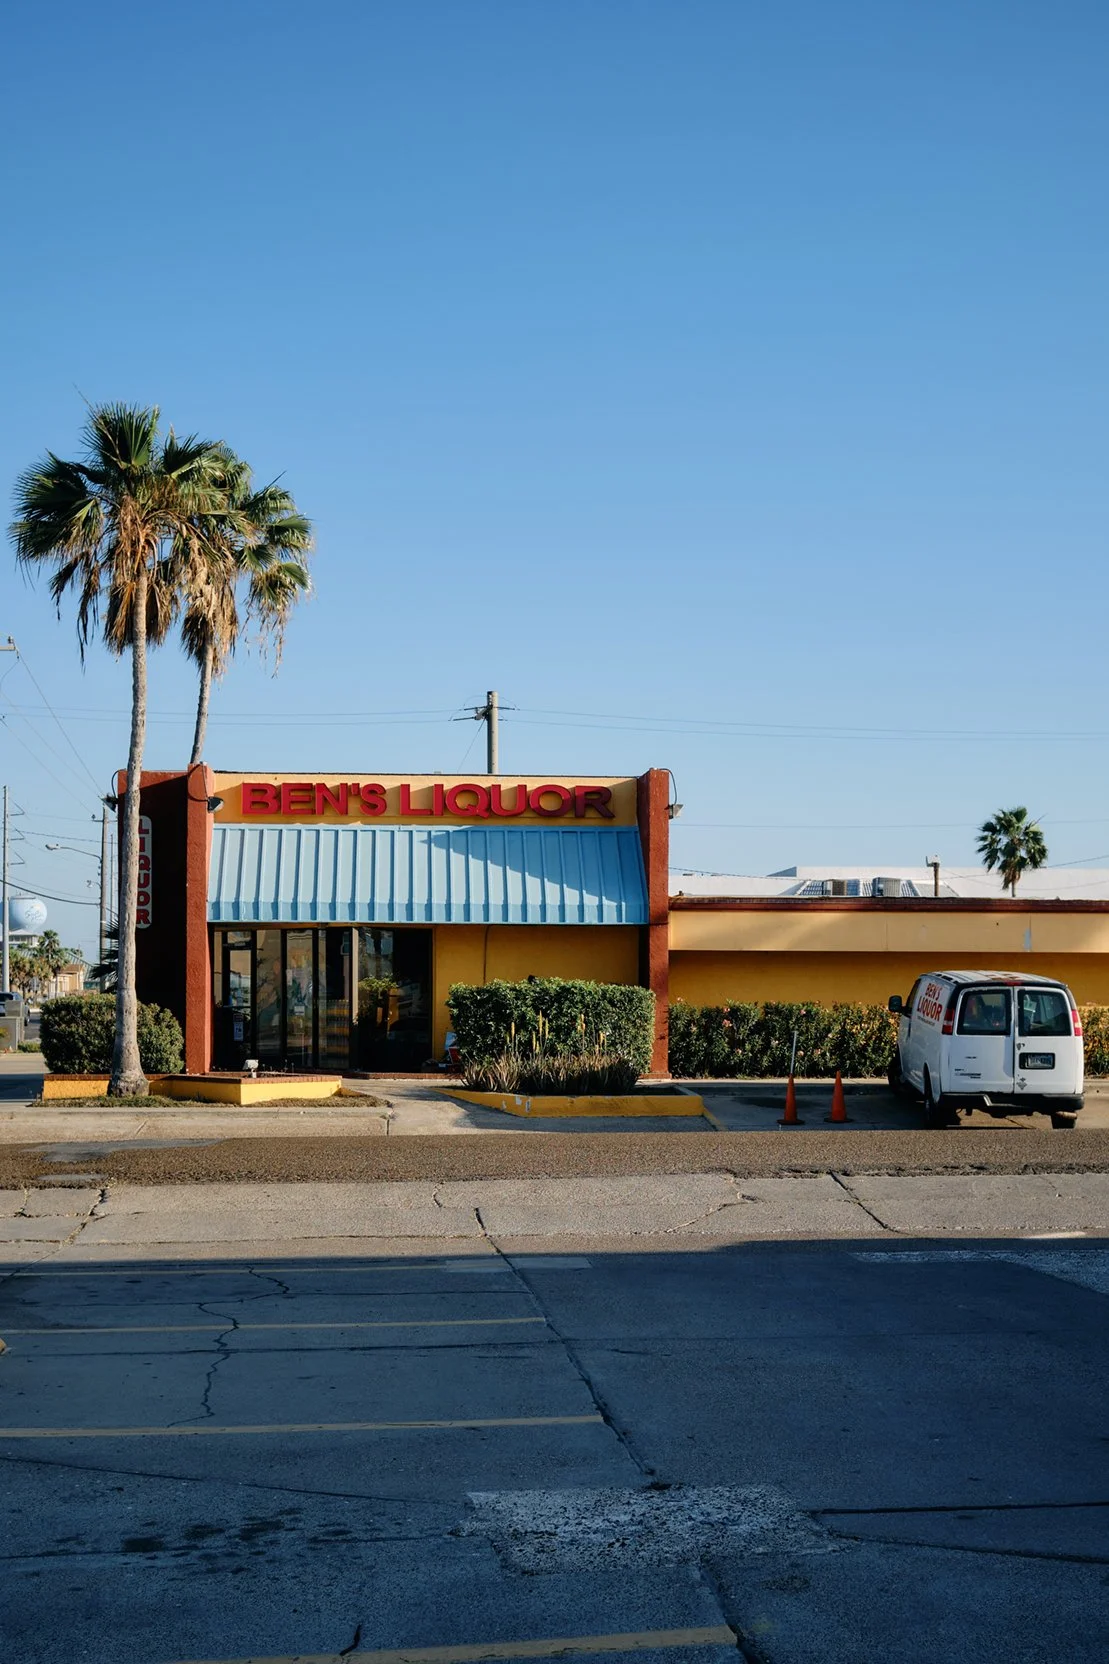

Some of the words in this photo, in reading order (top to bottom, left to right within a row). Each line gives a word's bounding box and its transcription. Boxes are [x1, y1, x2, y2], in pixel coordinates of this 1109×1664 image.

[242, 783, 387, 816] BEN'S
[400, 784, 615, 819] LIQUOR
[137, 818, 151, 925] LIQUOR
[925, 982, 943, 1002] BEN'S
[917, 996, 943, 1022] LIQUOR
